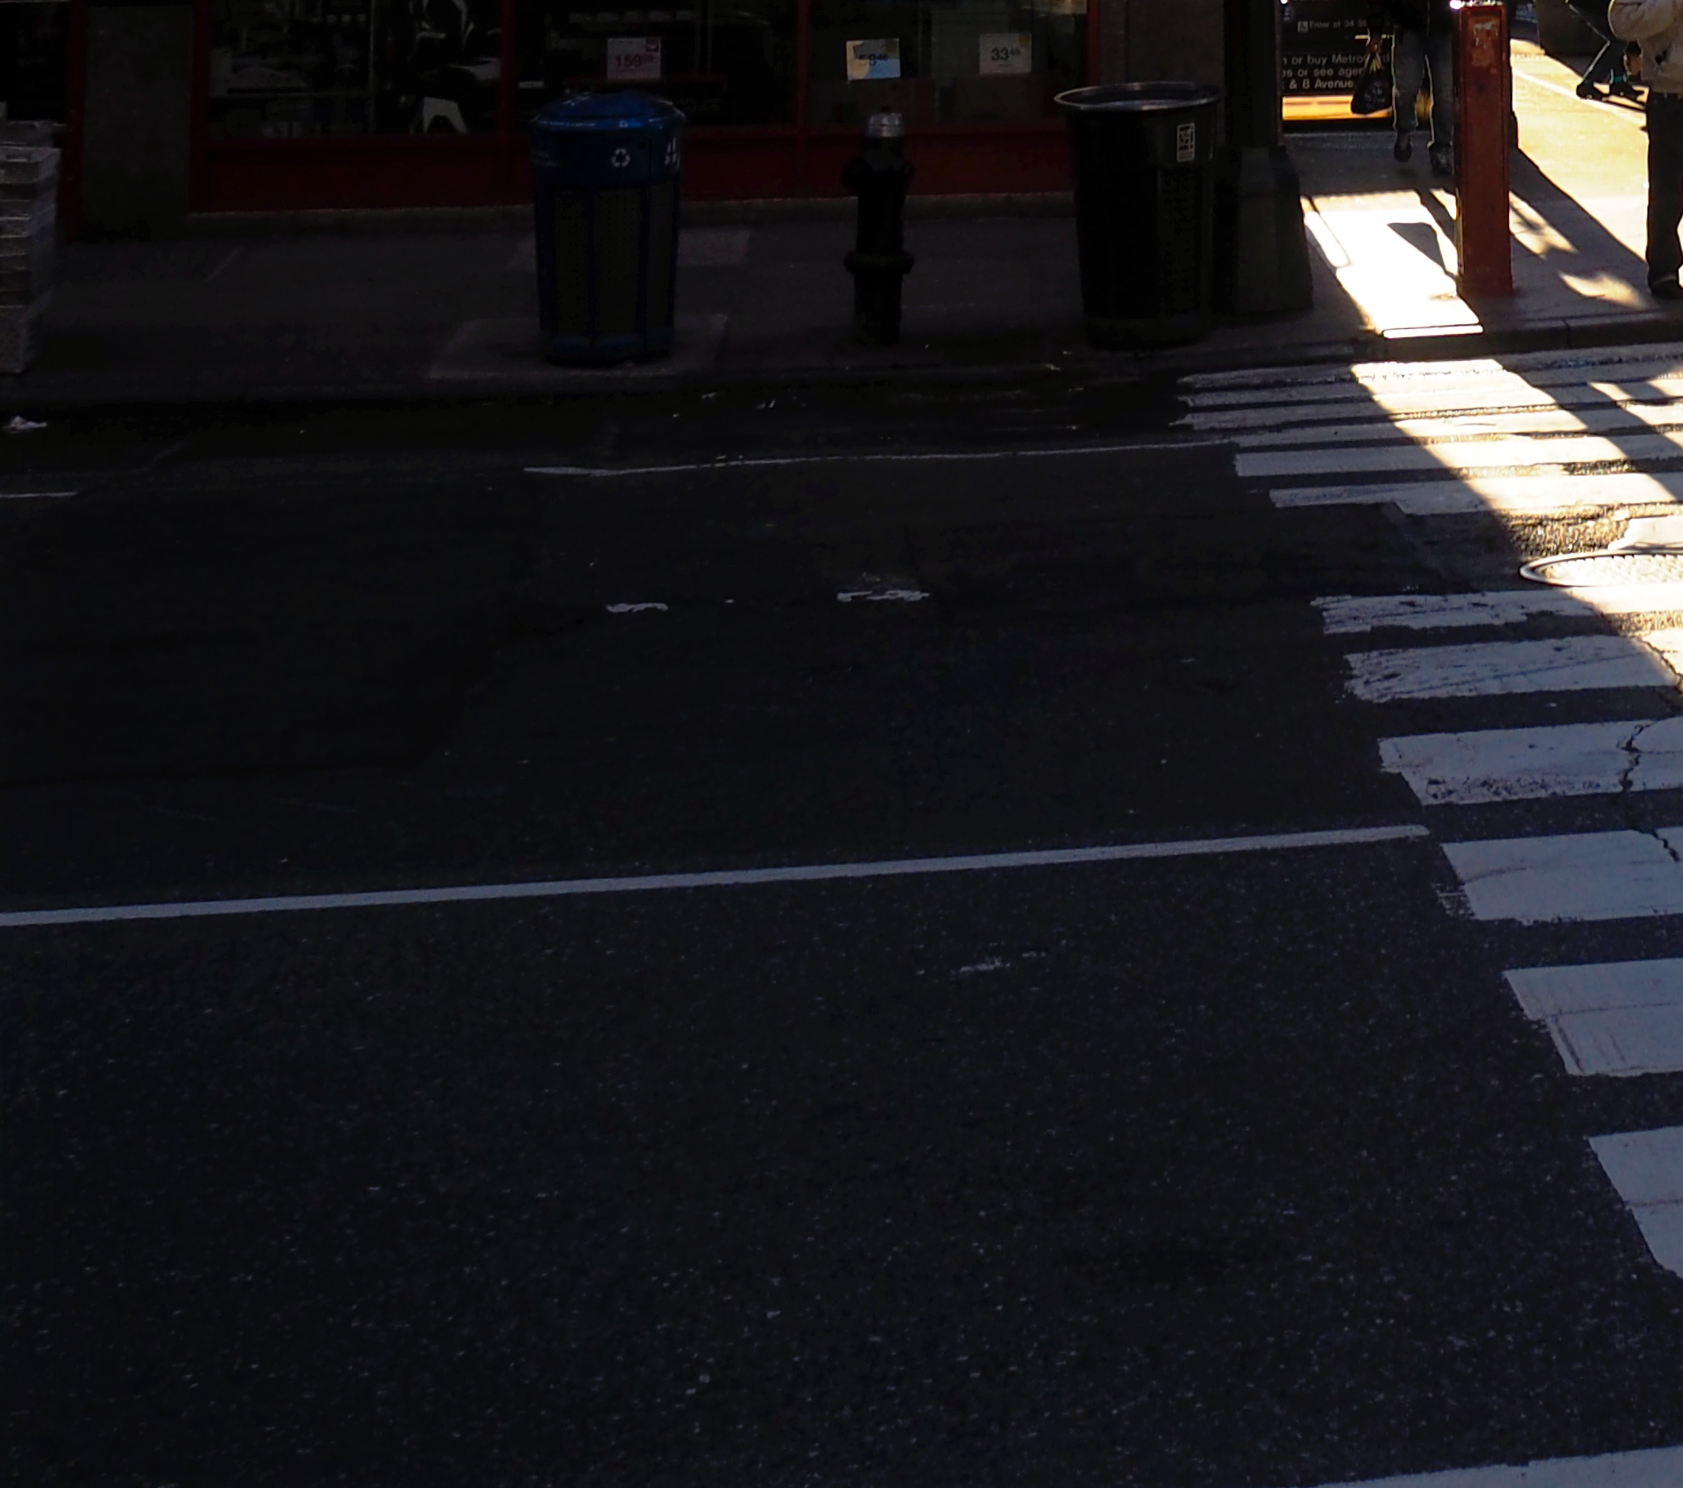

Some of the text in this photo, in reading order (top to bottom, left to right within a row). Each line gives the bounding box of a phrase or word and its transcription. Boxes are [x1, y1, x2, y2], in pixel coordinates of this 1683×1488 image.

[1291, 55, 1303, 64] or
[1307, 54, 1328, 68] buy
[1297, 68, 1308, 77] or
[1313, 68, 1334, 77] see
